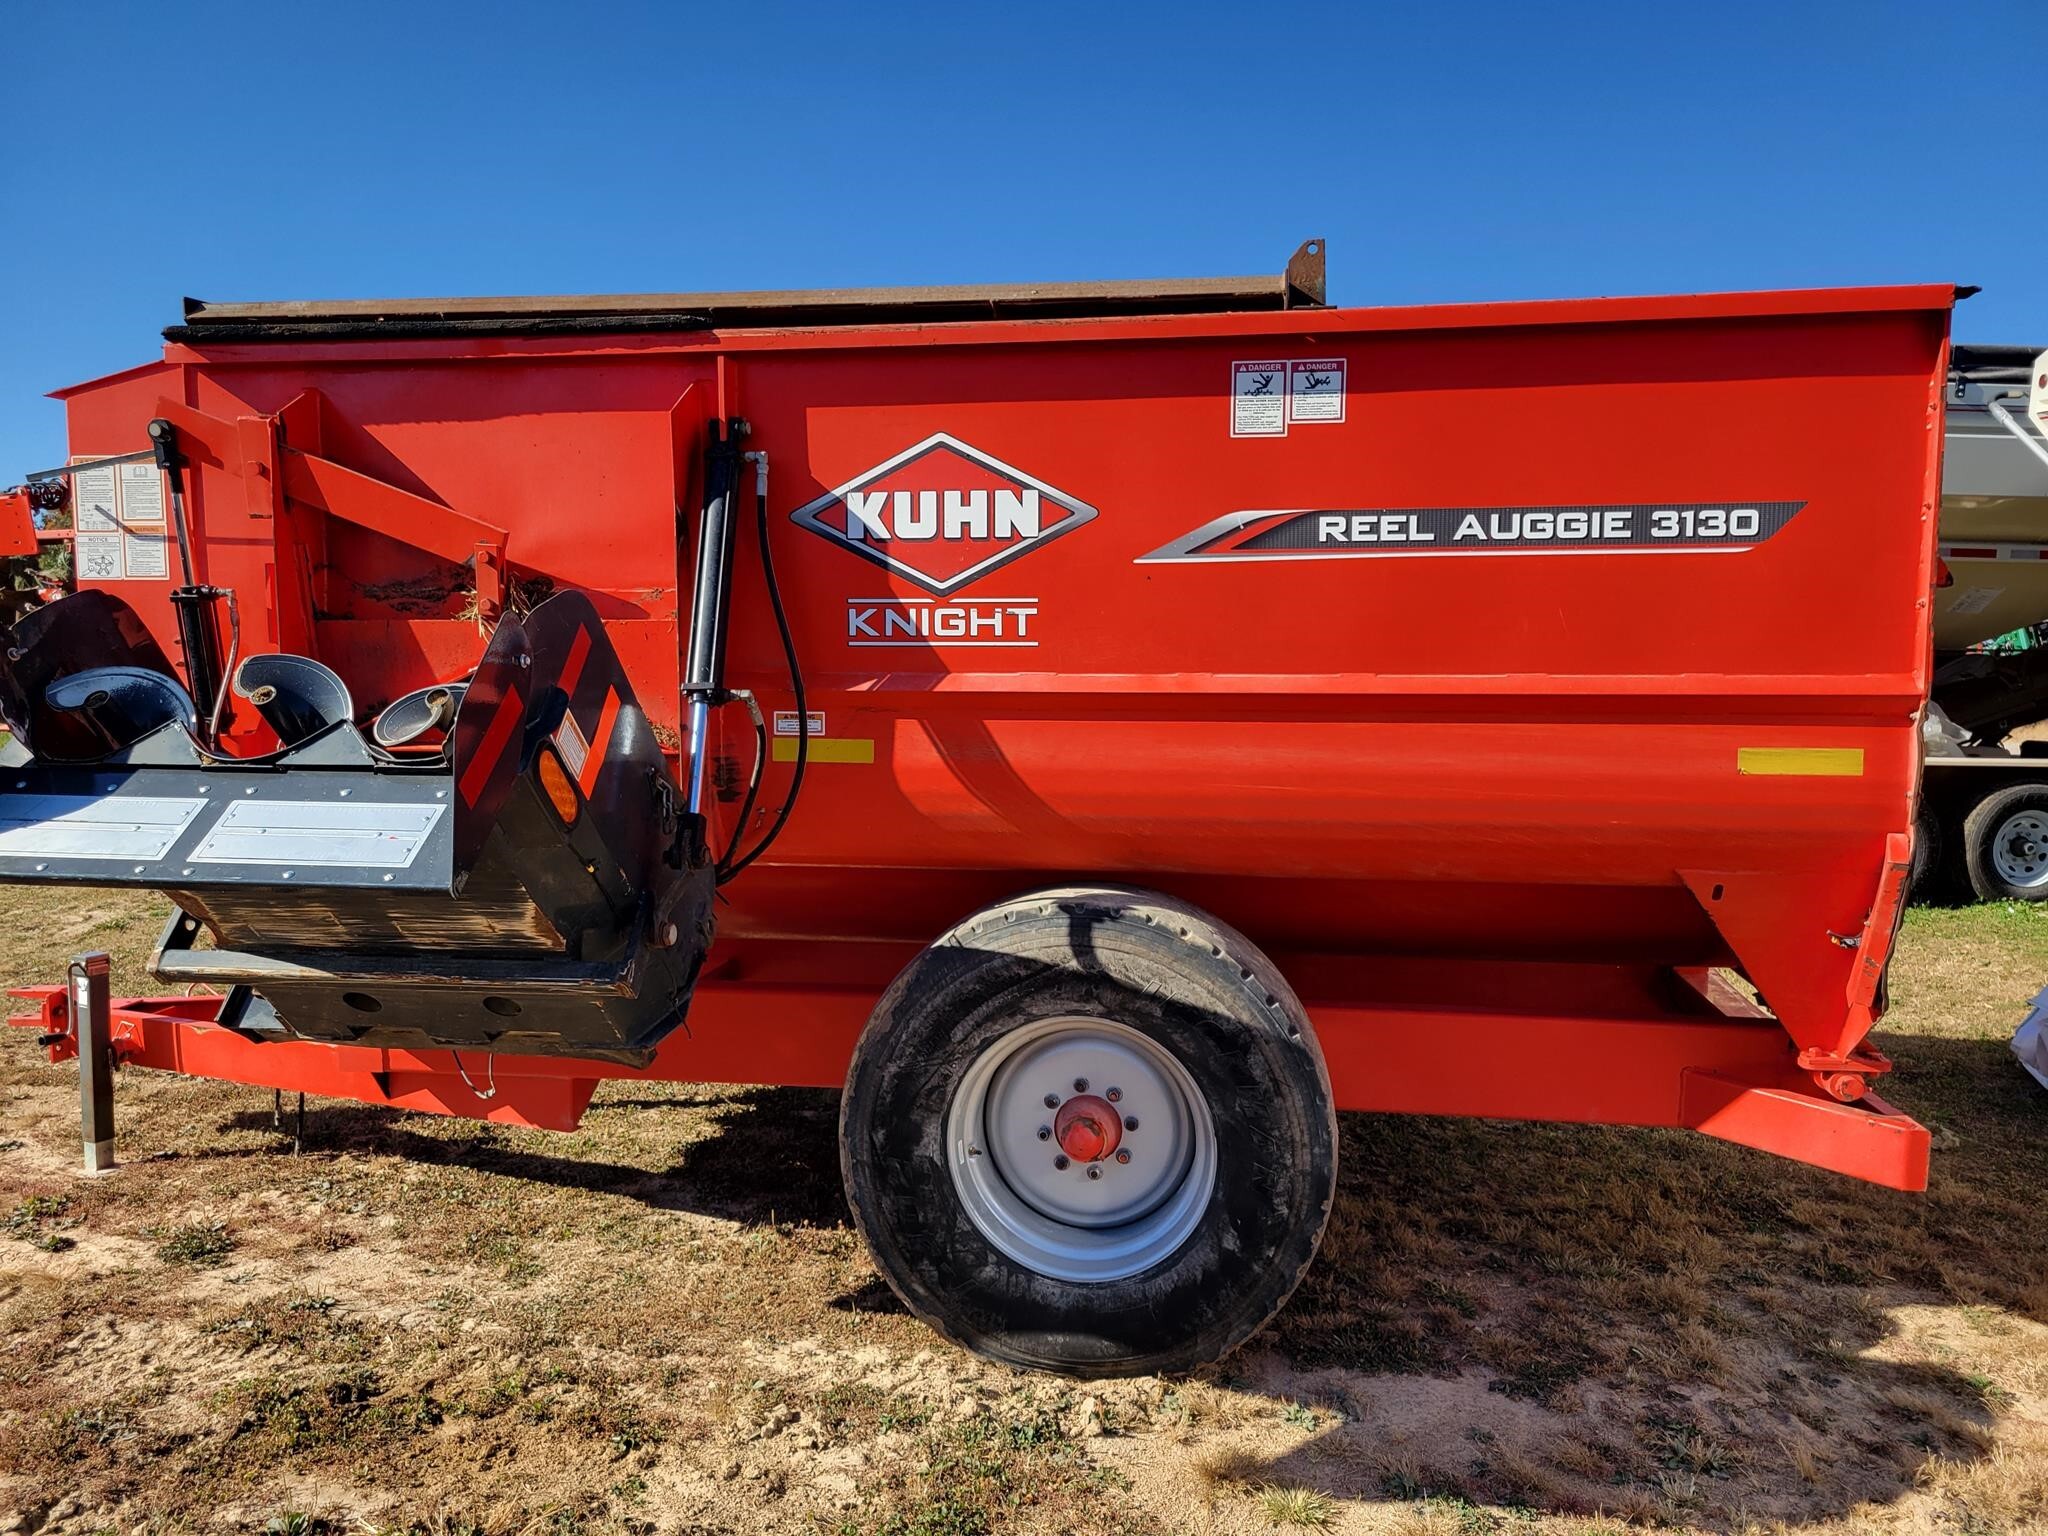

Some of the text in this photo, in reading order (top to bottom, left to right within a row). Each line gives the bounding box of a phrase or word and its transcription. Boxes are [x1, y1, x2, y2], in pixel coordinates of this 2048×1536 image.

[846, 489, 1039, 539] KUHN
[1318, 509, 1760, 542] REEL AUGGIE 3130
[848, 608, 1038, 636] KNIGHT
